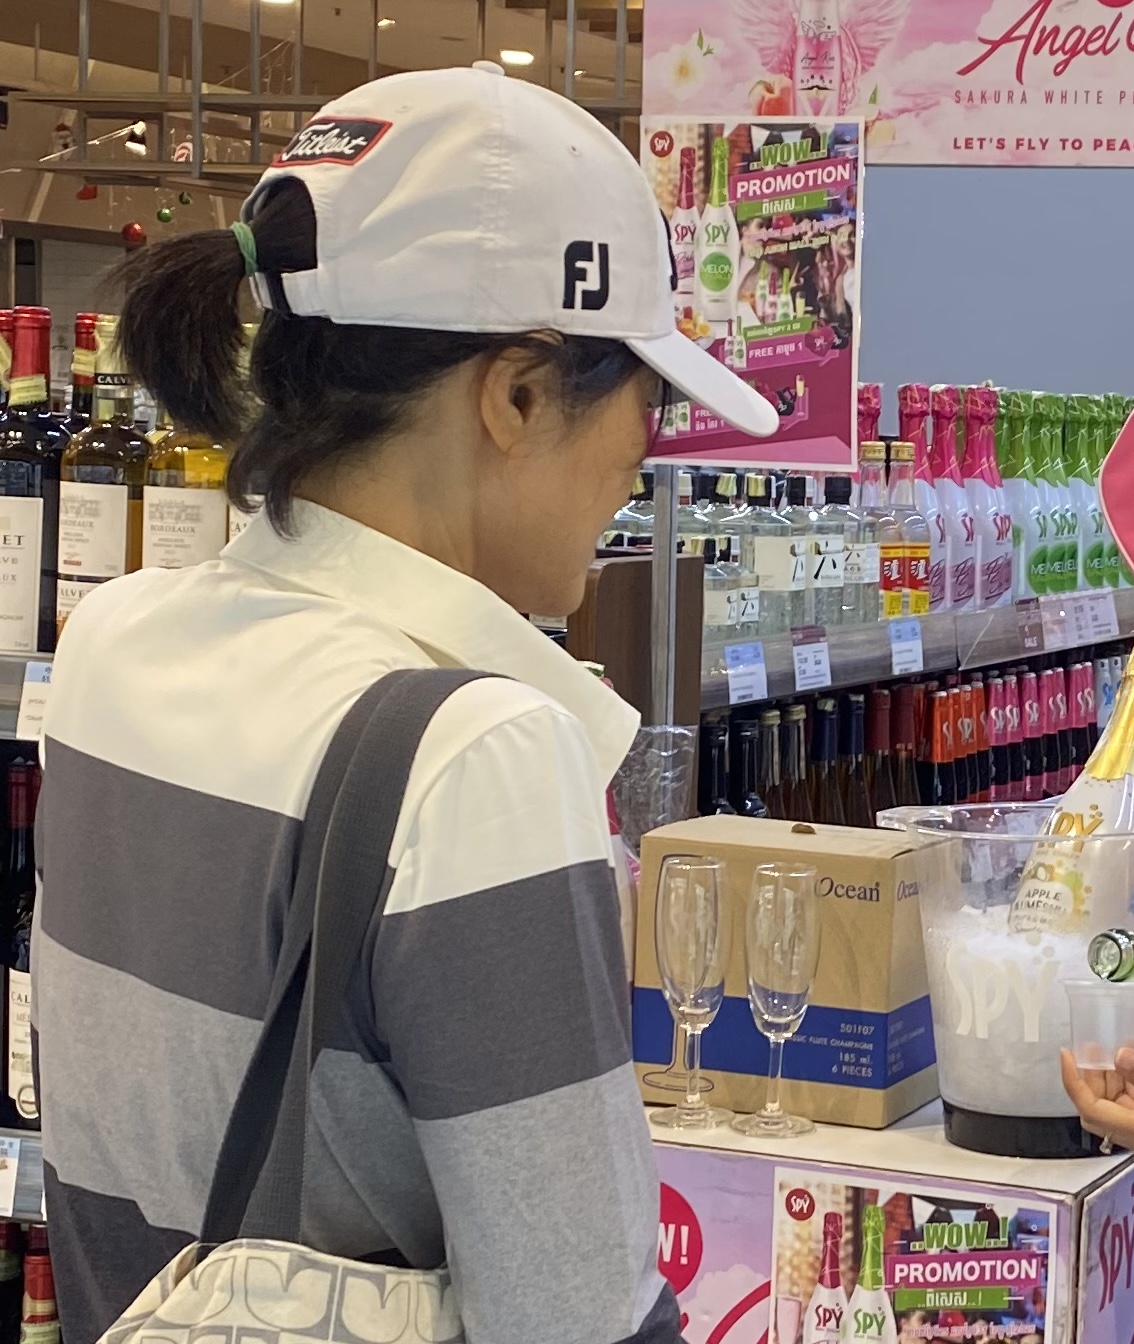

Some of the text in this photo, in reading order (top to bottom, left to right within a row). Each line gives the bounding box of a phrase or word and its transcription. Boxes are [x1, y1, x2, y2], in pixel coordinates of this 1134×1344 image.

[954, 90, 1028, 105] SAKURA
[1045, 90, 1104, 105] WHITE
[282, 122, 368, 161] Titleist
[953, 137, 1006, 151] LET'S
[1016, 138, 1050, 151] FLY
[1060, 138, 1084, 151] TO
[736, 163, 851, 199] PROMOTION
[675, 220, 697, 242] SPY
[705, 220, 731, 243] SPY
[749, 348, 774, 359] FREE
[97, 375, 130, 384] CALV
[695, 409, 713, 418] FRE
[815, 876, 881, 902] Ocean
[896, 880, 920, 902] Ocea
[1025, 888, 1062, 902] APPLE
[946, 932, 1062, 1043] SPY
[842, 1065, 873, 1078] PIECES
[791, 1194, 810, 1214] SPY
[894, 1258, 1038, 1285] PROMOTION
[815, 1303, 844, 1330] SPY
[854, 1306, 887, 1336] SPY
